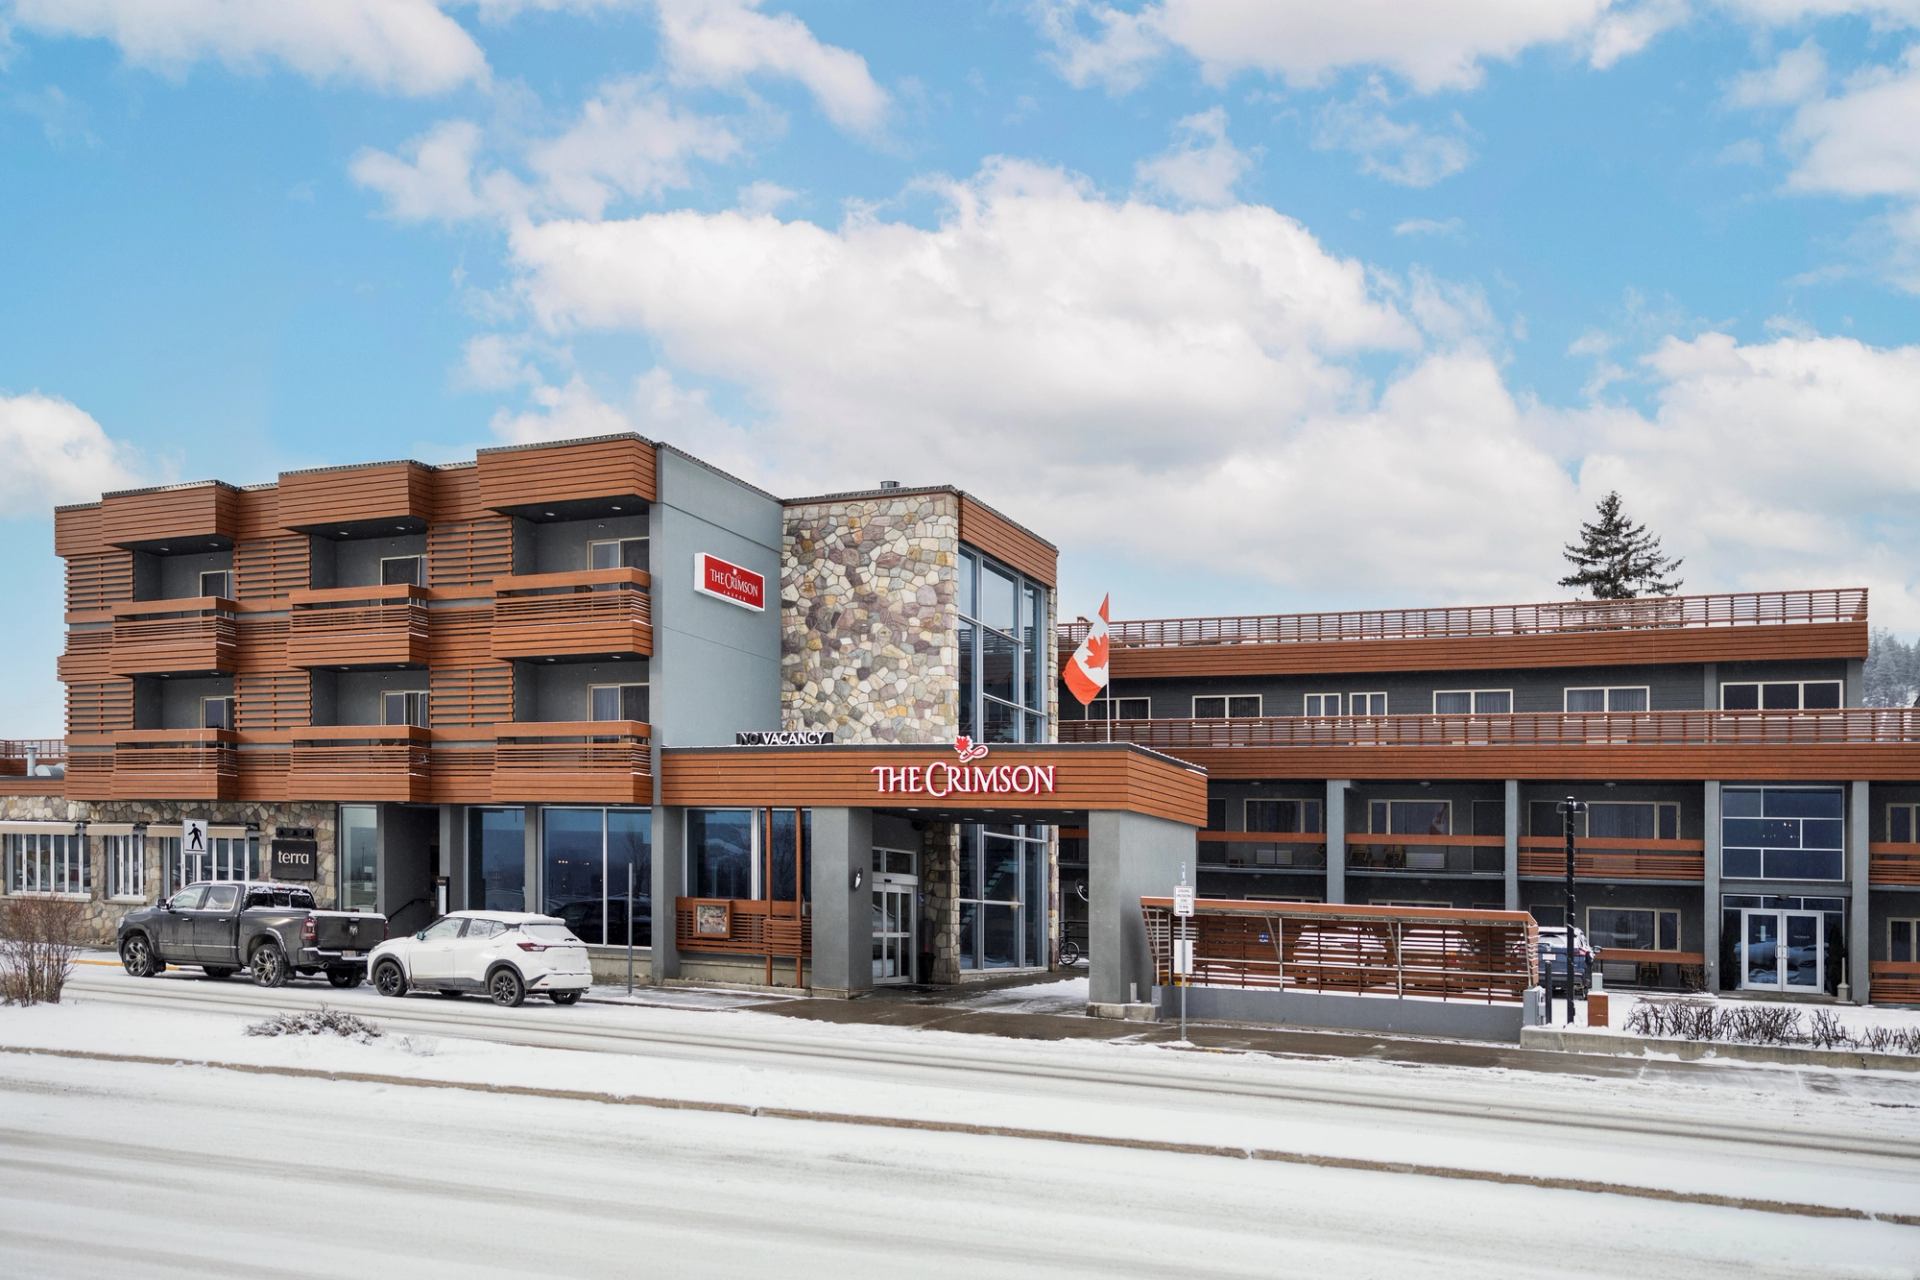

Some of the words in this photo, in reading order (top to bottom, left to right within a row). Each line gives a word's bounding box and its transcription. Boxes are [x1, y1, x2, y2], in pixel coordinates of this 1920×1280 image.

[710, 568, 724, 585] THE
[725, 573, 758, 597] CRIMSON
[740, 732, 759, 745] NO
[762, 732, 826, 745] VACANCY
[870, 766, 924, 794] THE
[925, 761, 1056, 798] CRIMSON
[277, 850, 310, 865] terra
